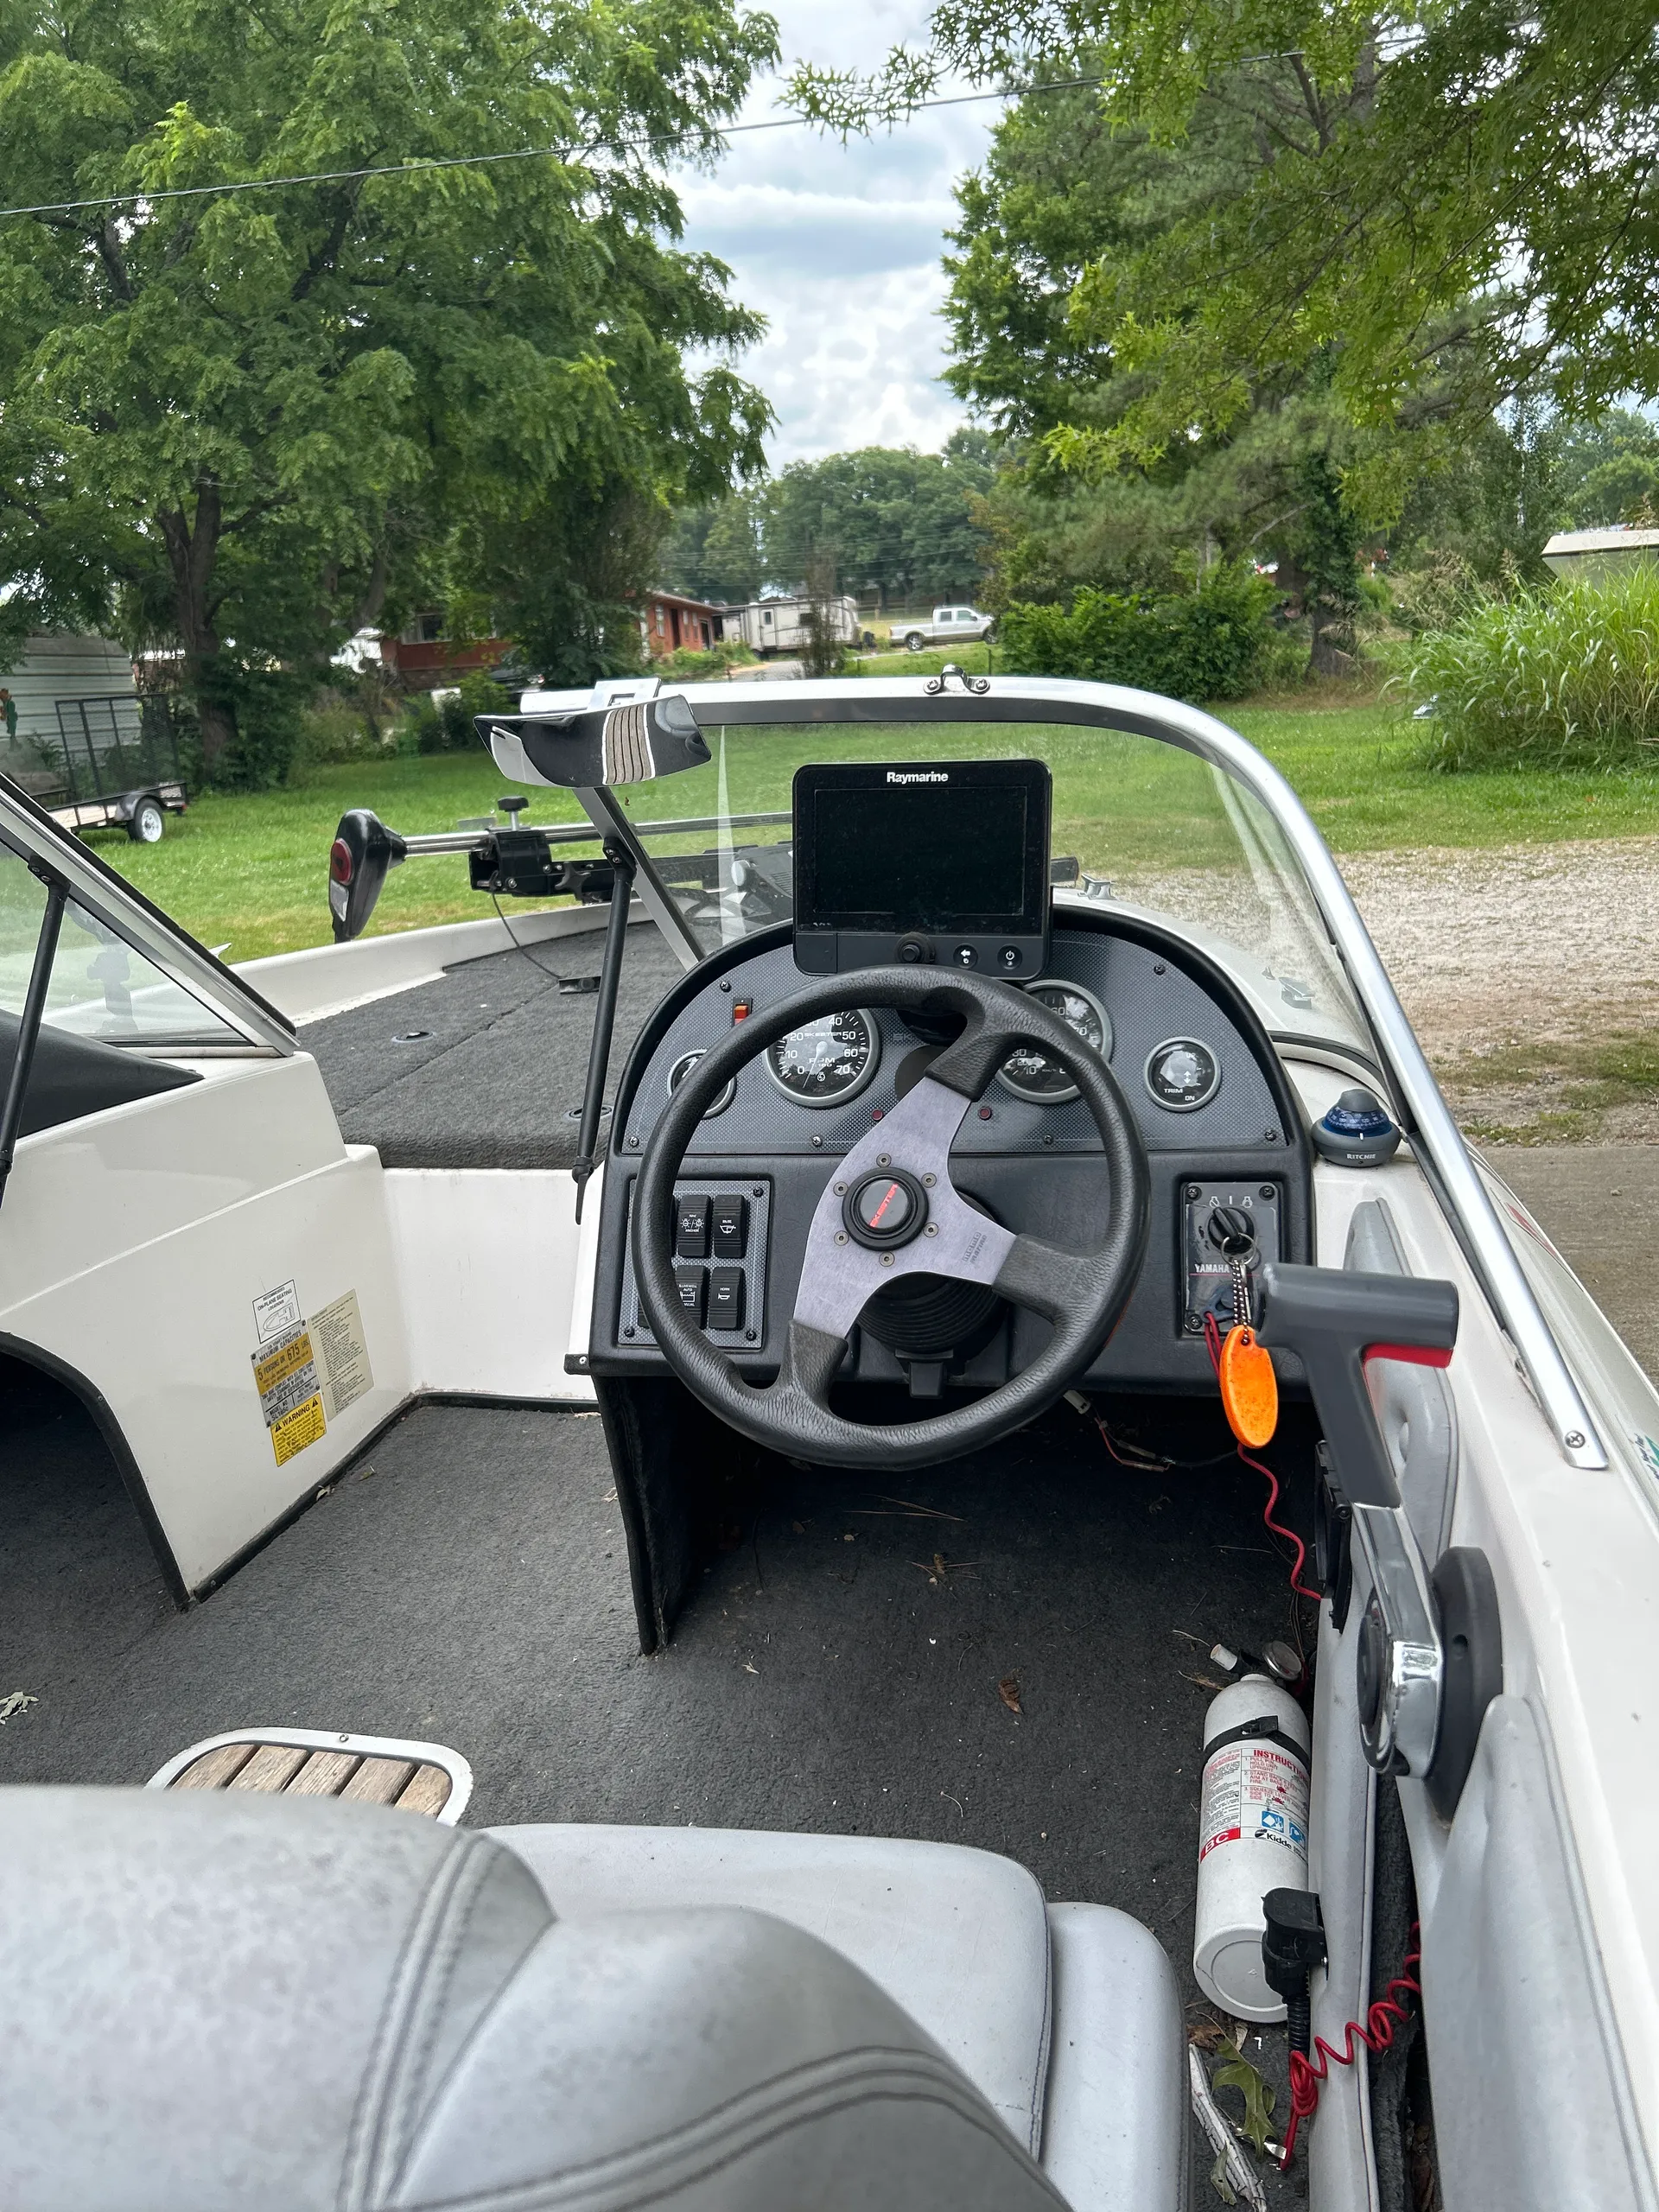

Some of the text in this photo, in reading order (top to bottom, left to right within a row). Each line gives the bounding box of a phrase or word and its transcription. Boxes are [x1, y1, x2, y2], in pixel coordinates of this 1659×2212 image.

[887, 771, 949, 785] Raymarine
[829, 1017, 842, 1026] 40
[790, 1032, 804, 1041] 20
[842, 1031, 855, 1039] 50
[786, 1050, 798, 1058] 10
[844, 1049, 858, 1058] 60
[836, 1065, 850, 1074] 70
[1025, 1065, 1037, 1075] 10
[1194, 1263, 1230, 1274] YAMAHA
[257, 1367, 264, 1381] 5
[286, 1342, 300, 1361] 675
[282, 1402, 309, 1427] WARNING
[1205, 1833, 1229, 1854] BC
[1267, 1833, 1292, 1850] Kidde
